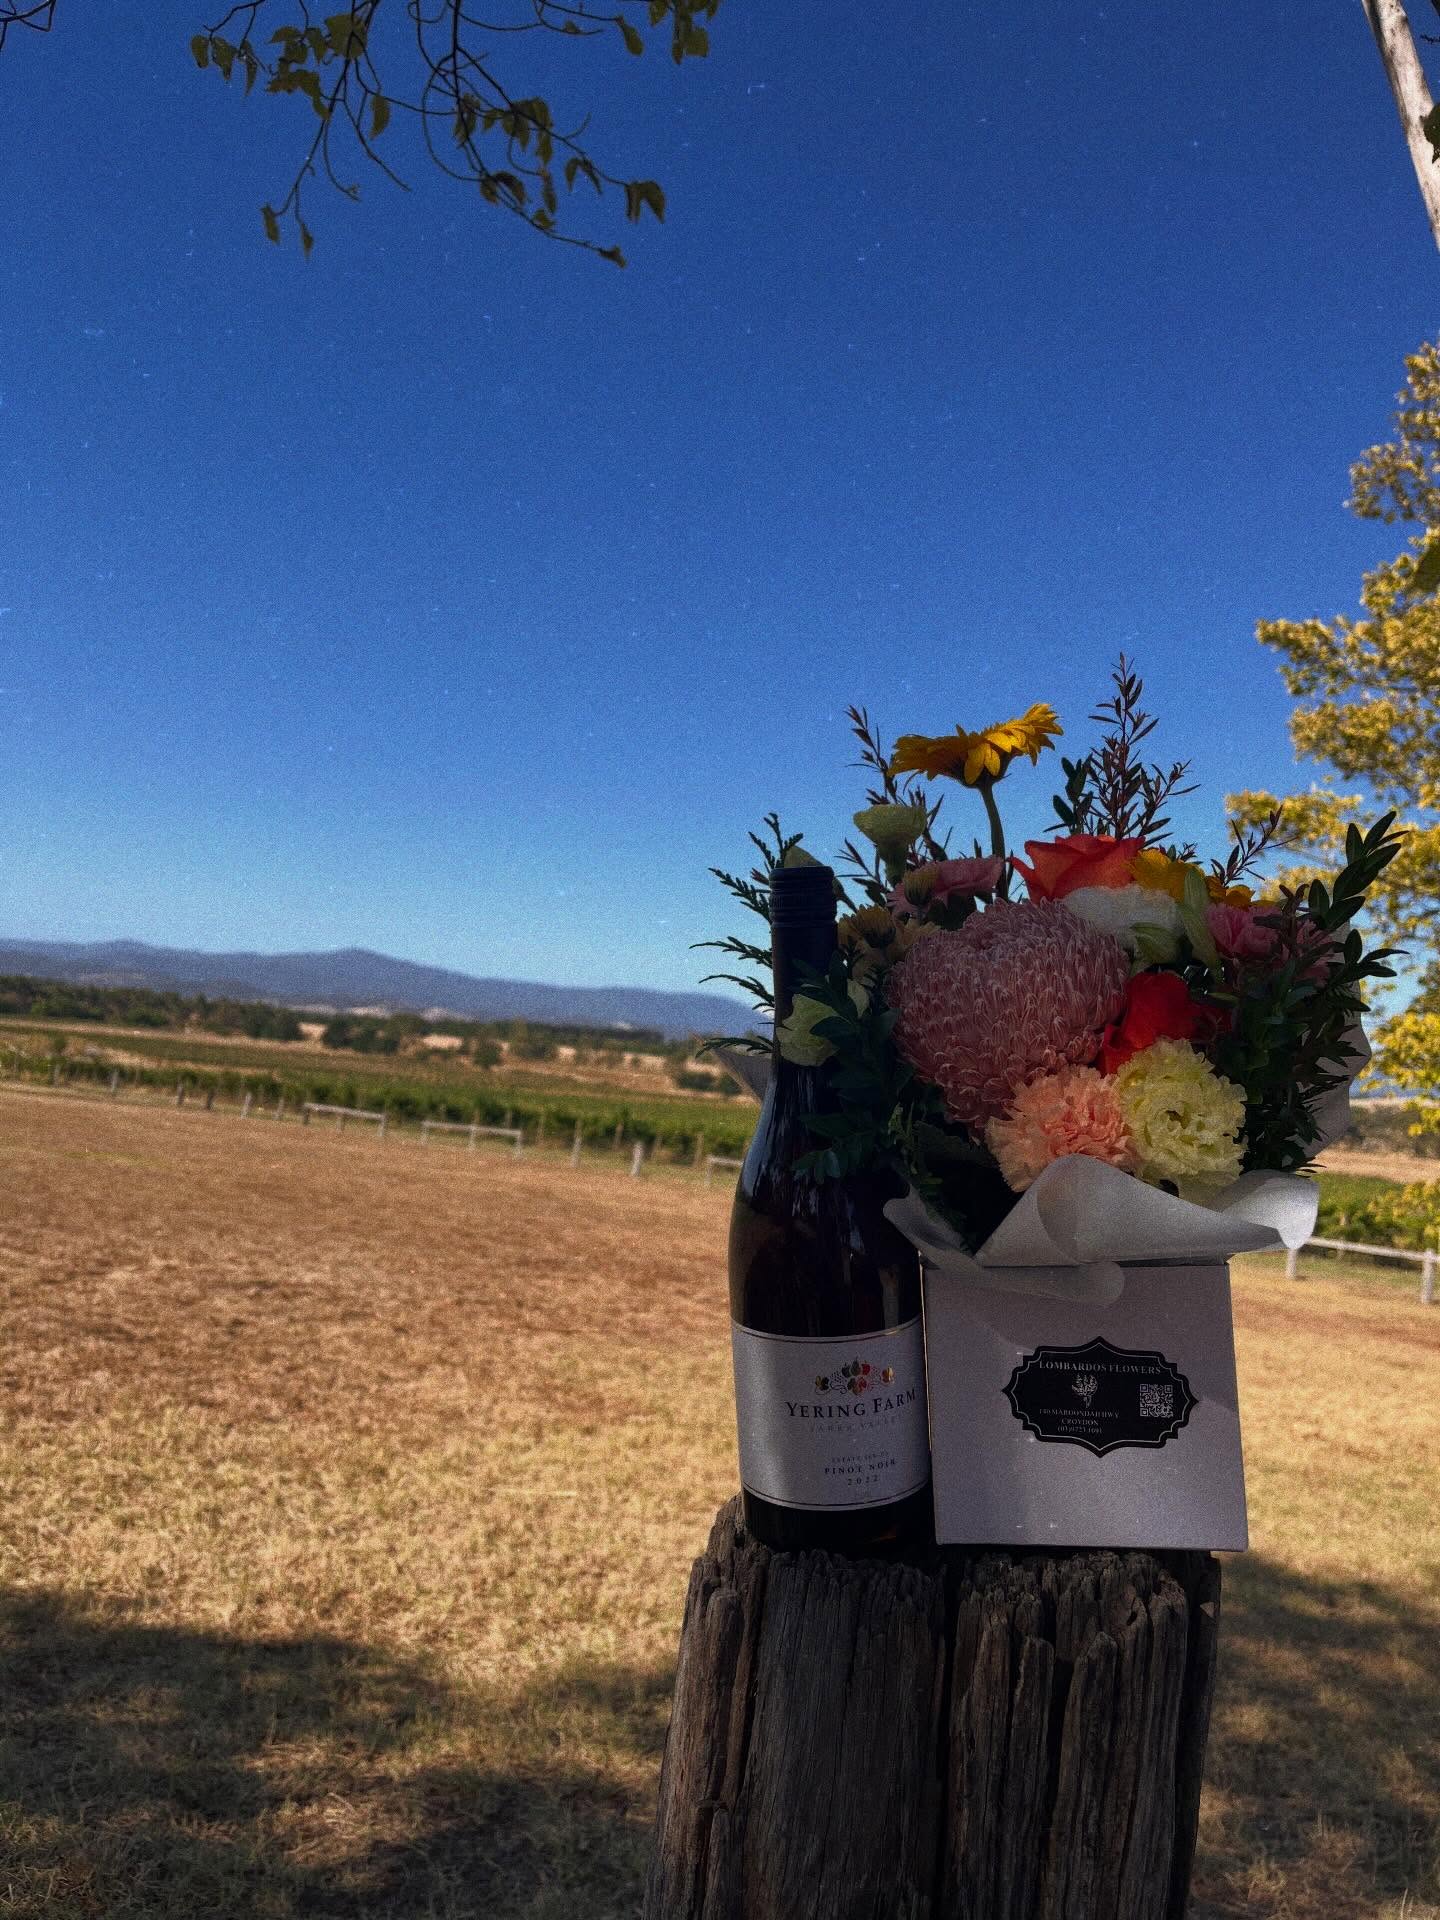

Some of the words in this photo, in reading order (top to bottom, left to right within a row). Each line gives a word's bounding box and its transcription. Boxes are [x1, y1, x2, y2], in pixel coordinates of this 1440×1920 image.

[1039, 1361, 1106, 1372] LOMBARDOS
[1109, 1364, 1161, 1375] FLOWERS
[785, 1400, 866, 1418] YERING
[872, 1388, 916, 1413] FARM
[824, 1465, 862, 1475] PINOT
[869, 1458, 896, 1471] NOIR
[847, 1474, 879, 1486] 2022
